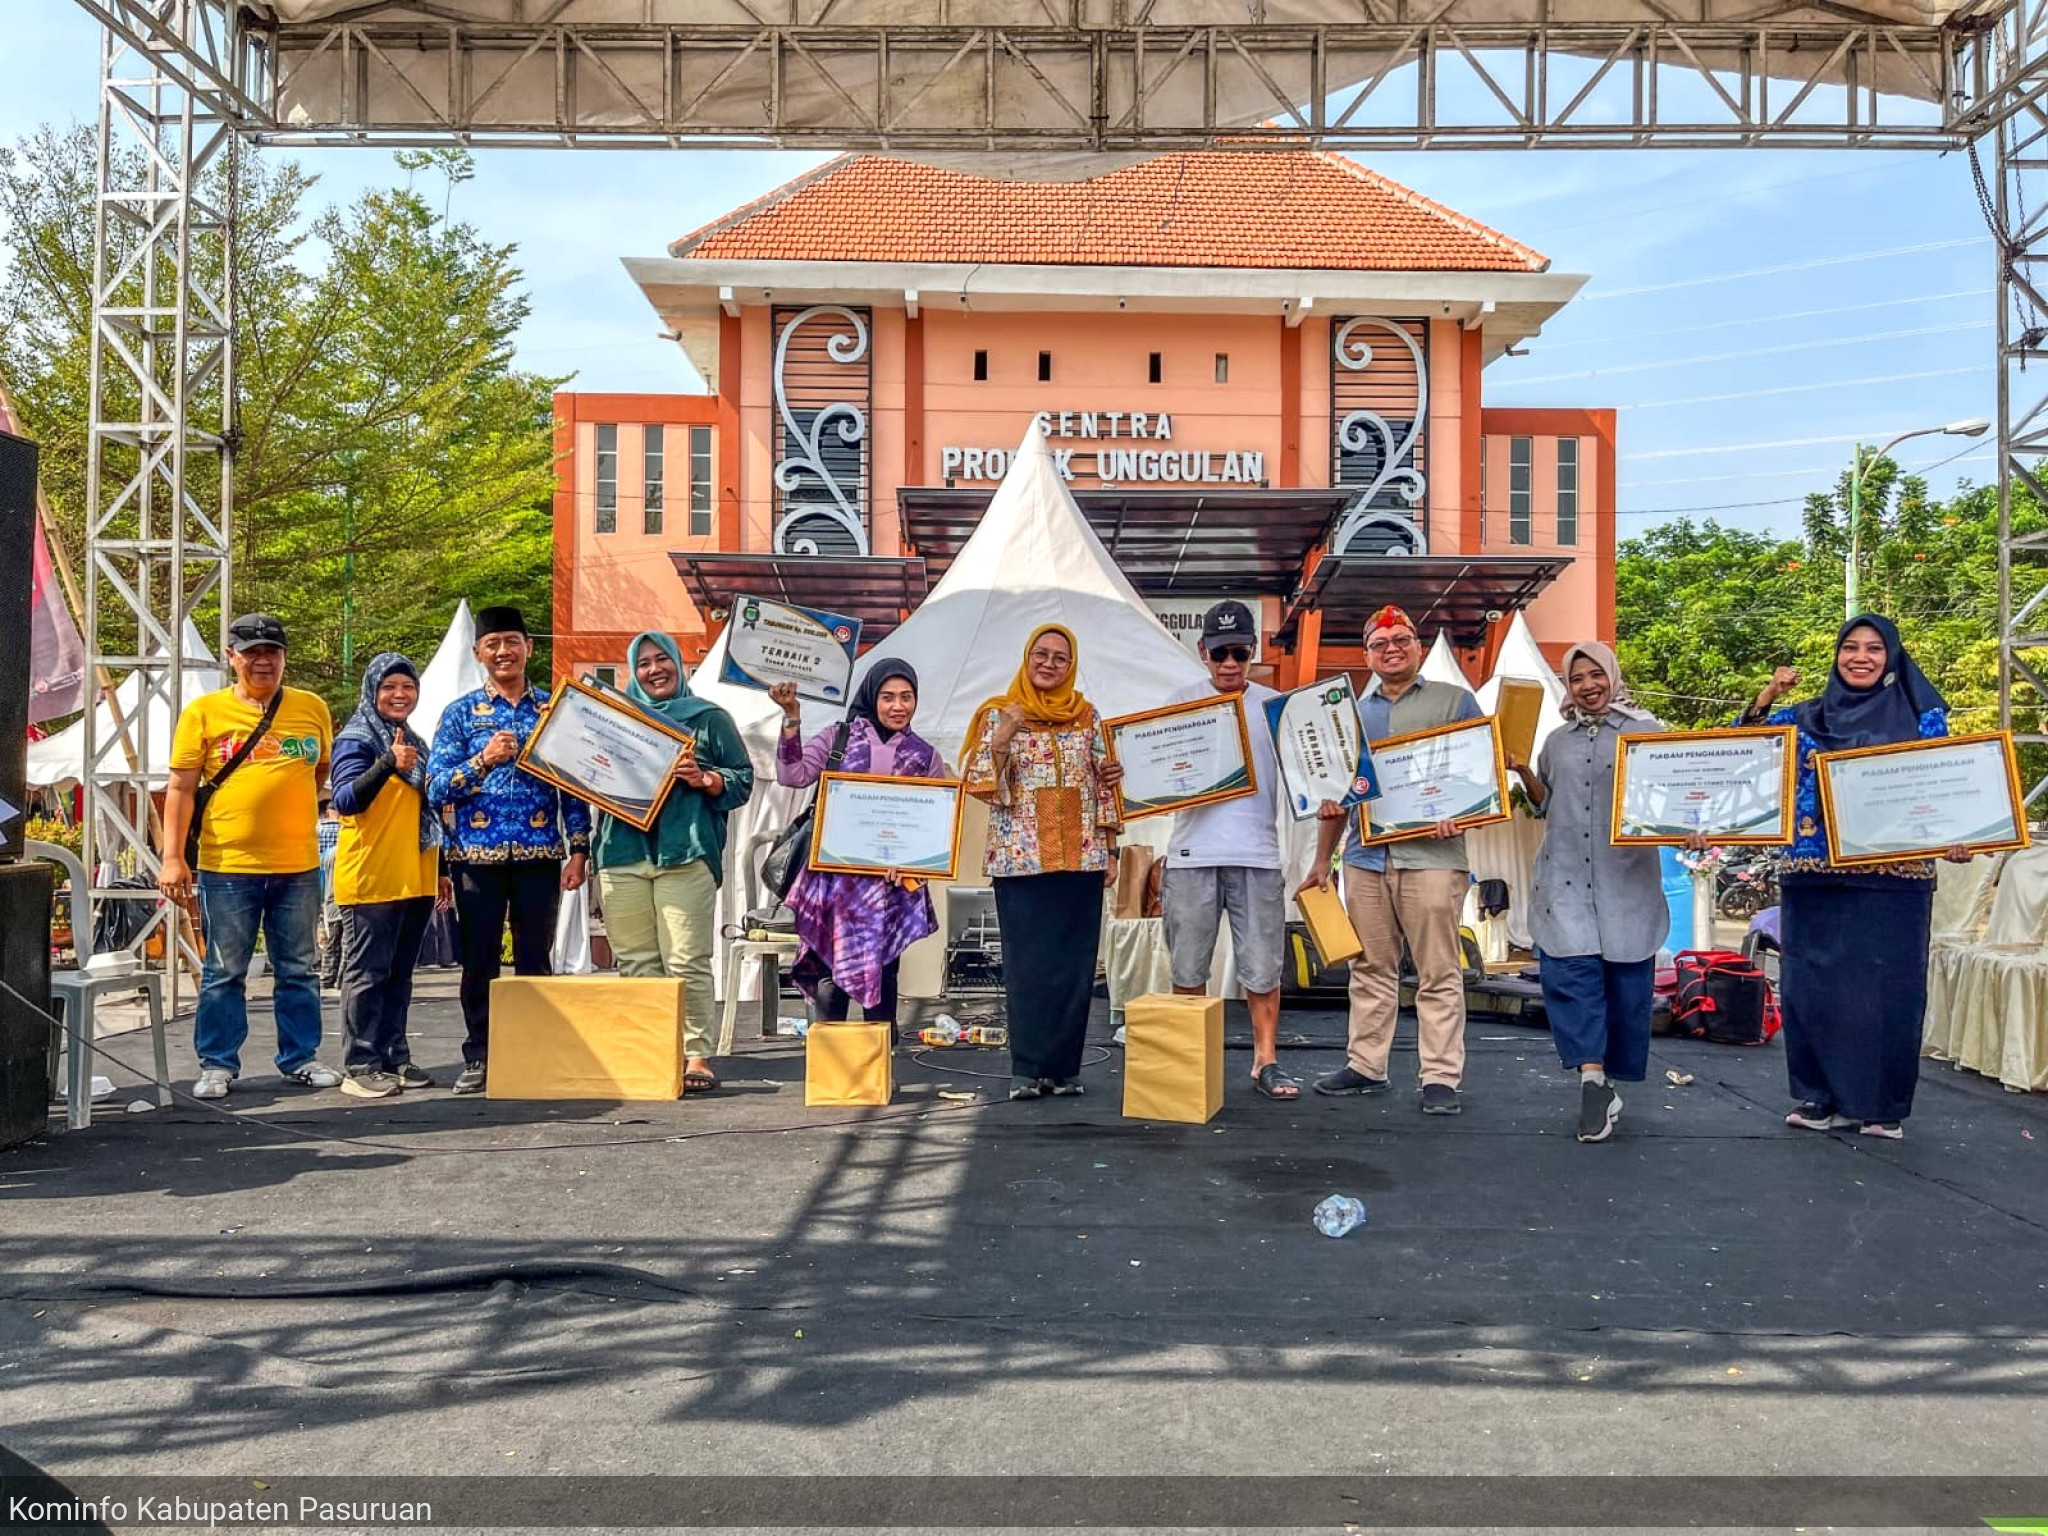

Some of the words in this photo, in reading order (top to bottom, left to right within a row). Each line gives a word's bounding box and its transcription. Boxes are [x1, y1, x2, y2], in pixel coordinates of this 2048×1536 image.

[1035, 411, 1172, 440] SENTRA
[942, 446, 1076, 482] PROK
[1097, 449, 1263, 483] UNGGULAN
[1156, 613, 1206, 630] GGULA
[761, 646, 810, 663] TERBAIK
[1134, 729, 1163, 740] PIAGAM
[1164, 718, 1217, 734] PENGHARGAAN
[1304, 721, 1326, 768] TERBAIK
[1649, 750, 1684, 760] PIAGAM
[1685, 748, 1753, 758] PENGHARGAAN
[1861, 766, 1900, 778] PIAGAM
[1900, 758, 1975, 773] PENGHARGAAN
